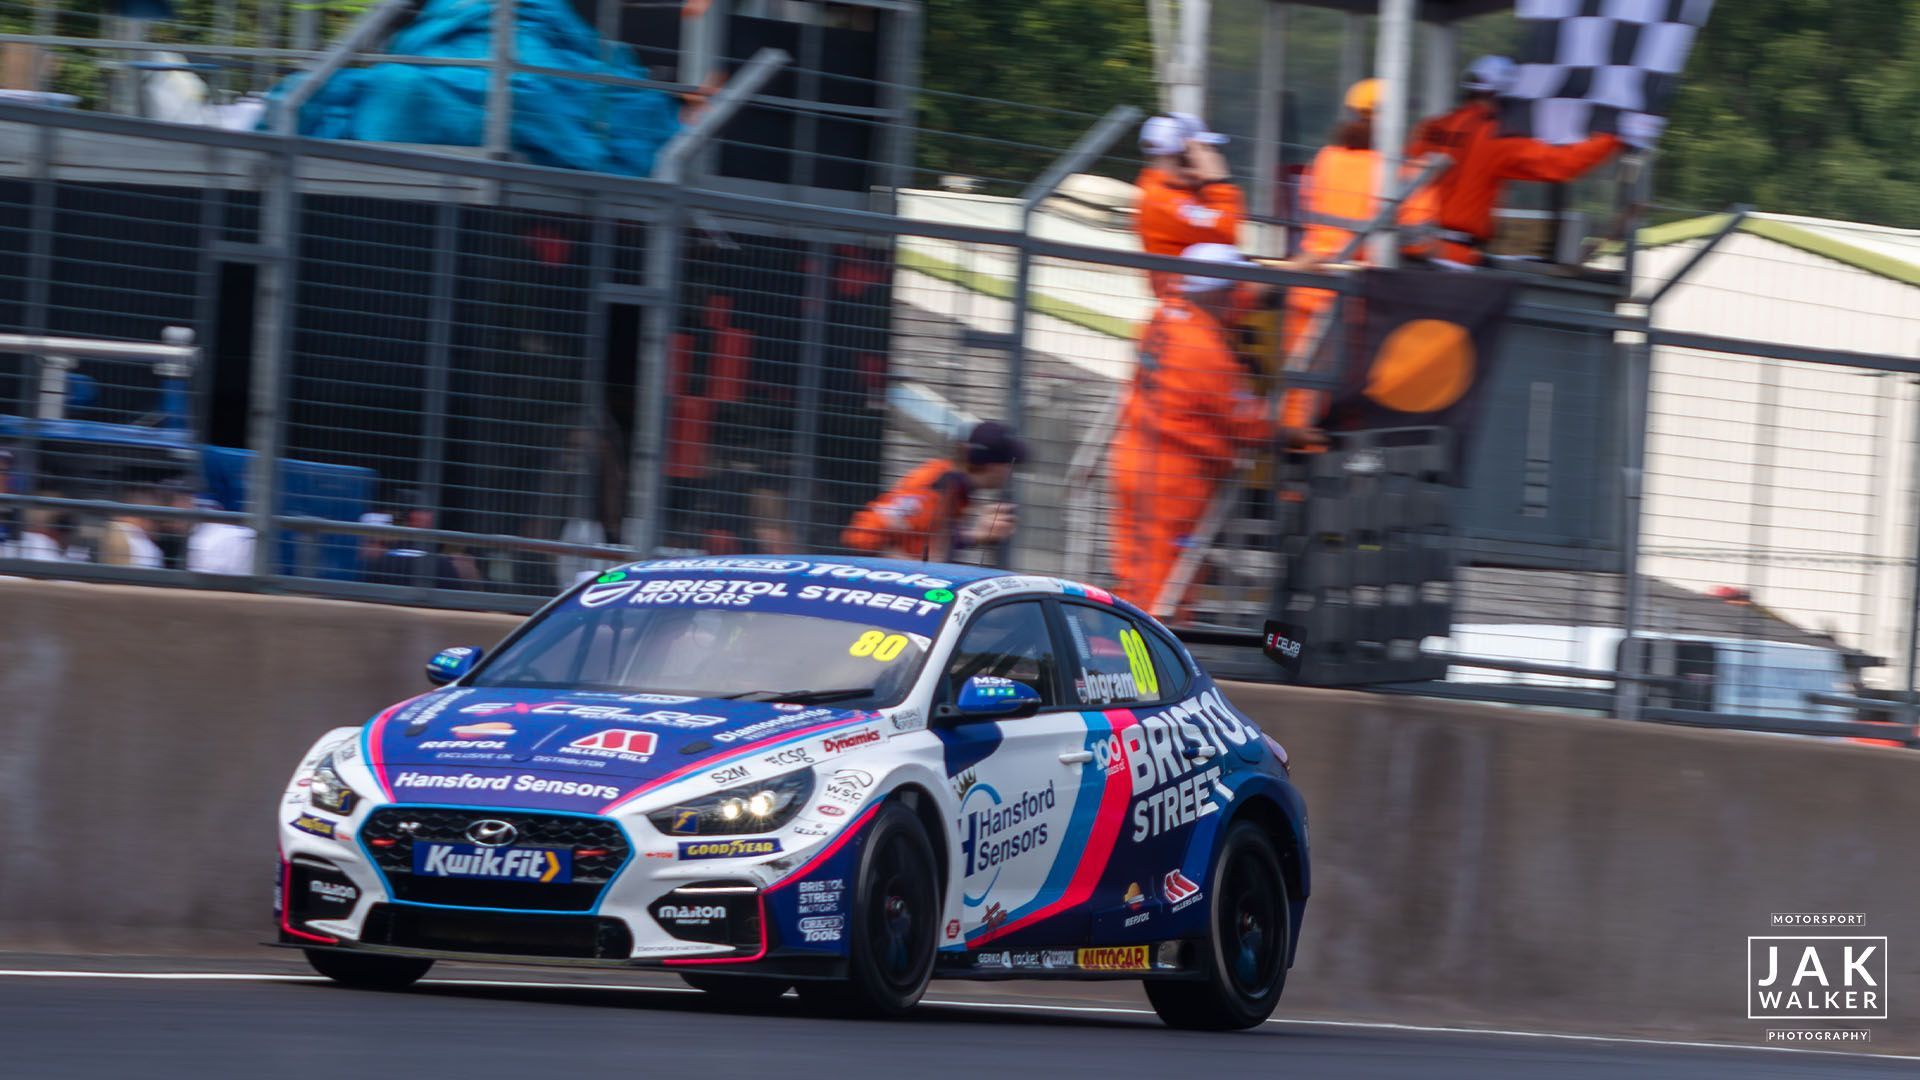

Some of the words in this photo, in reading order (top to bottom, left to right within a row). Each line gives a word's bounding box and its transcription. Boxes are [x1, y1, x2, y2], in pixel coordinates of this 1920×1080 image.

[808, 563, 953, 588] Tools
[629, 592, 754, 605] MOTORS
[640, 580, 788, 596] BRISTOL
[798, 585, 943, 616] STREET
[849, 630, 909, 662] 80
[1120, 629, 1159, 694] 80
[1082, 666, 1138, 704] Ingram
[418, 741, 507, 750] REPSOL
[823, 730, 880, 753] Dynamics
[1091, 734, 1121, 770] 100
[1121, 687, 1259, 796] BRISTOL
[558, 747, 617, 758] MILLERS
[618, 753, 650, 763] OILS
[395, 771, 512, 790] Hansford
[514, 775, 620, 799] Sensors
[711, 765, 751, 784] S2M
[827, 784, 863, 800] WSC
[979, 779, 1056, 840] Hansford
[1132, 766, 1235, 843] STREET
[687, 841, 774, 856] GOODYEAR
[978, 822, 1048, 872] Sensors
[800, 879, 846, 892] BRISTOL
[799, 903, 838, 914] MOTORS
[800, 891, 842, 904] STREET
[805, 930, 841, 942] Tools
[1083, 947, 1145, 969] AUTOCAR
